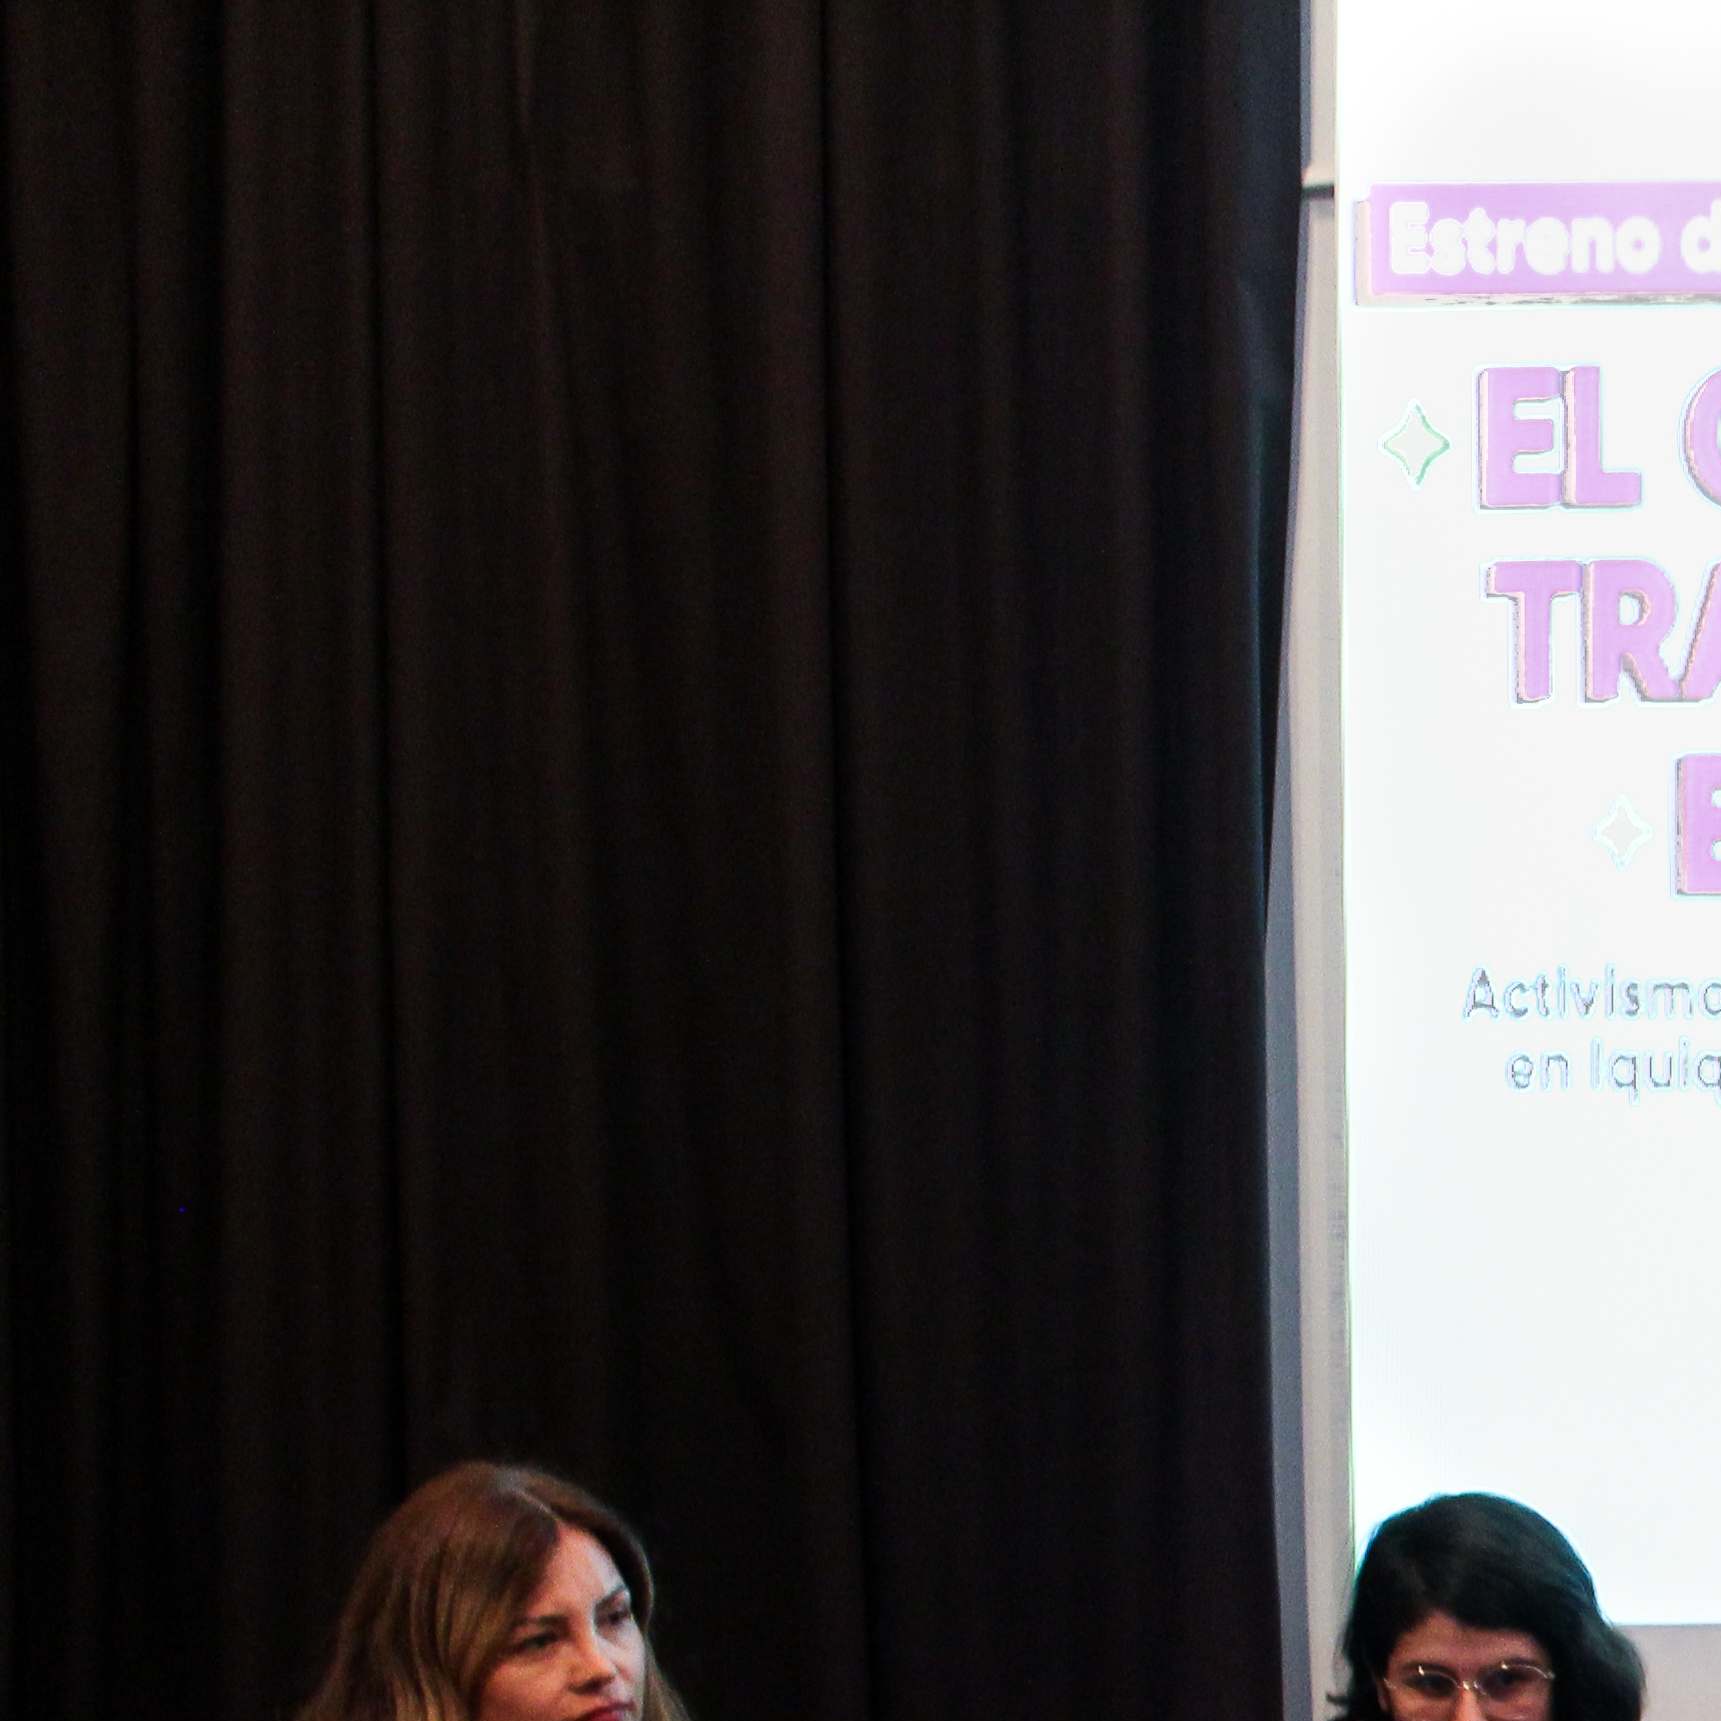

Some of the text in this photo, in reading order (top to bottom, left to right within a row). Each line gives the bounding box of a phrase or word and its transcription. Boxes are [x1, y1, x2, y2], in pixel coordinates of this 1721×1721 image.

[1388, 200, 1661, 276] Estreno
[1475, 363, 1643, 512] EL
[1503, 1051, 1572, 1092] en
